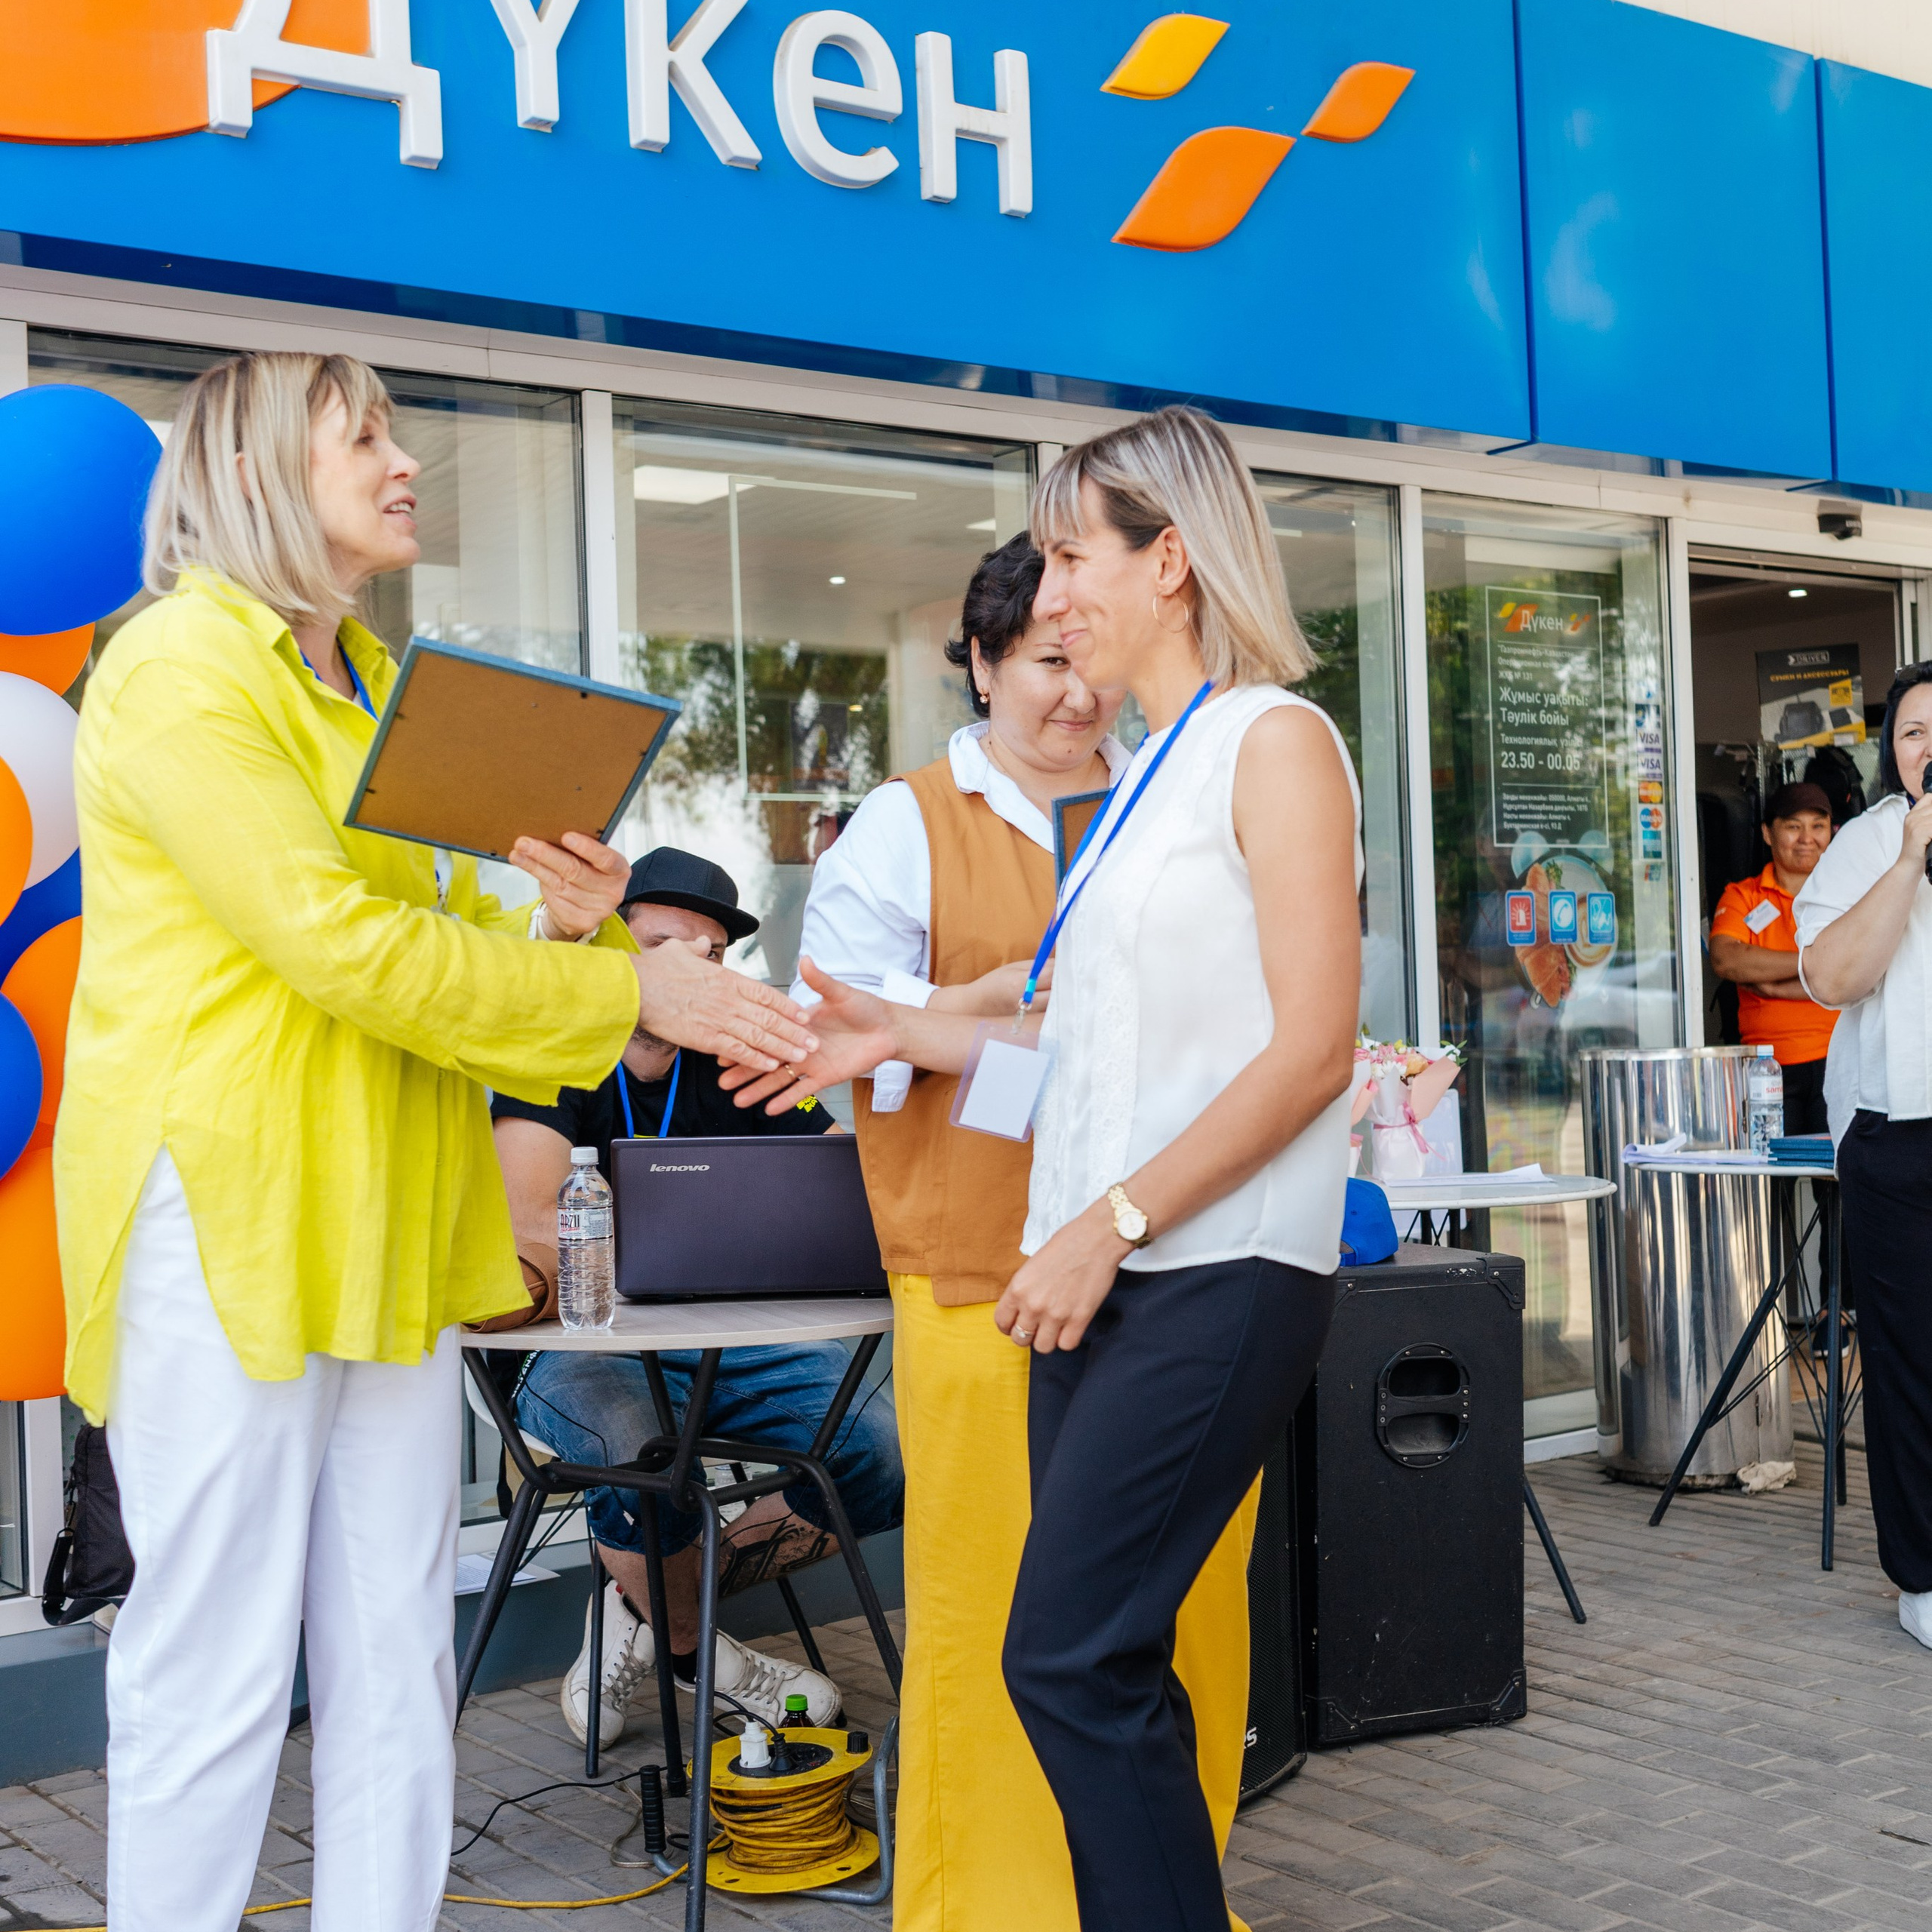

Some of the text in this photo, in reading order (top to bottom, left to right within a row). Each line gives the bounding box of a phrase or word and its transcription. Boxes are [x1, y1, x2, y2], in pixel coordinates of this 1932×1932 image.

[1520, 610, 1564, 632] Дүкен
[1500, 687, 1541, 705] Жұмыс
[1500, 708, 1569, 726] Тәулік бойы
[1639, 734, 1660, 745] VISA
[1501, 751, 1535, 769] 23.50
[1547, 753, 1580, 771] 00.05
[1641, 758, 1661, 770] VISA
[650, 1164, 710, 1172] lenovo
